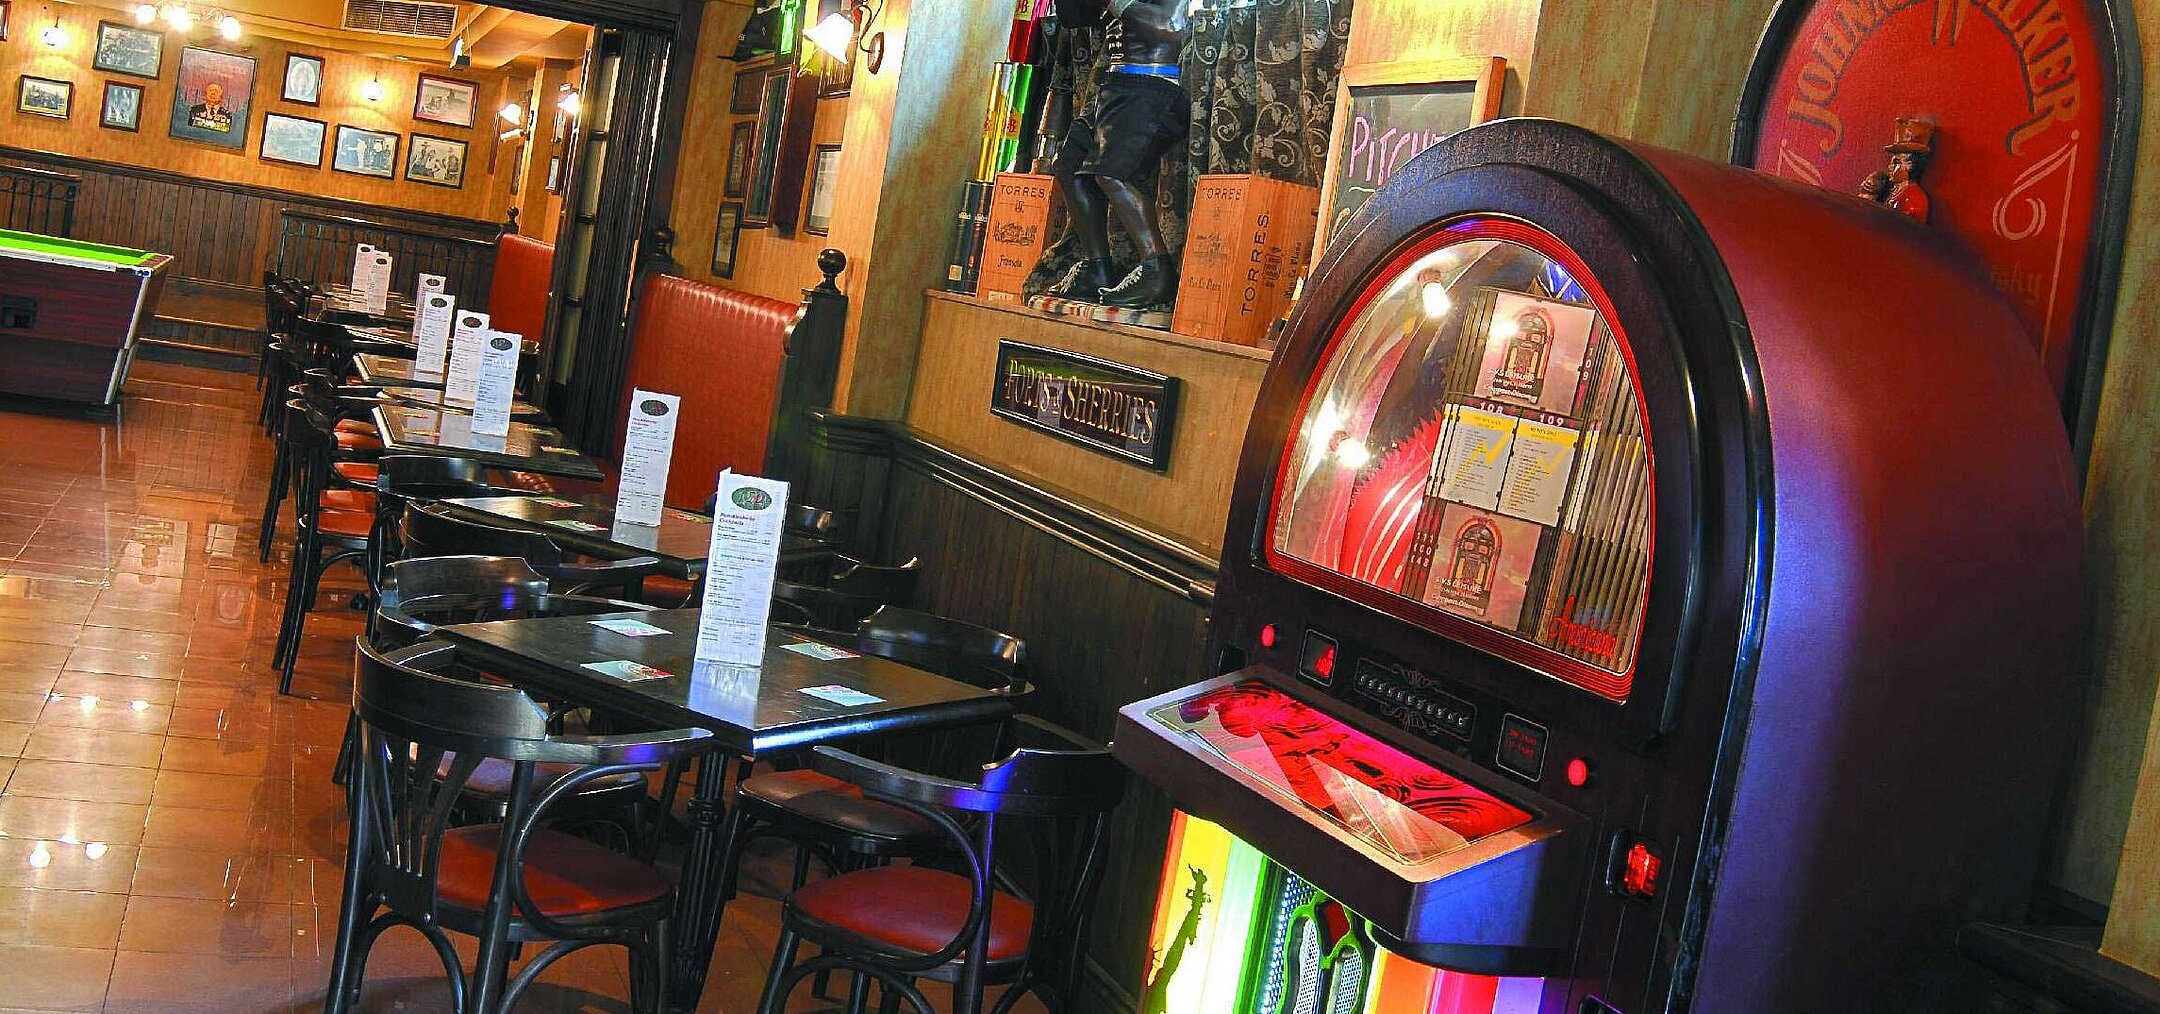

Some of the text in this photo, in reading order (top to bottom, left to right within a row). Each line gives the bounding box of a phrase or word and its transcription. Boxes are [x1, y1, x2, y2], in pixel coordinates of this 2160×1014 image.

[1000, 184, 1046, 200] TORRES
[1241, 214, 1270, 316] TORRES
[1063, 375, 1158, 444] SHERRIES
[1480, 402, 1504, 413] 108
[1539, 414, 1564, 427] 109
